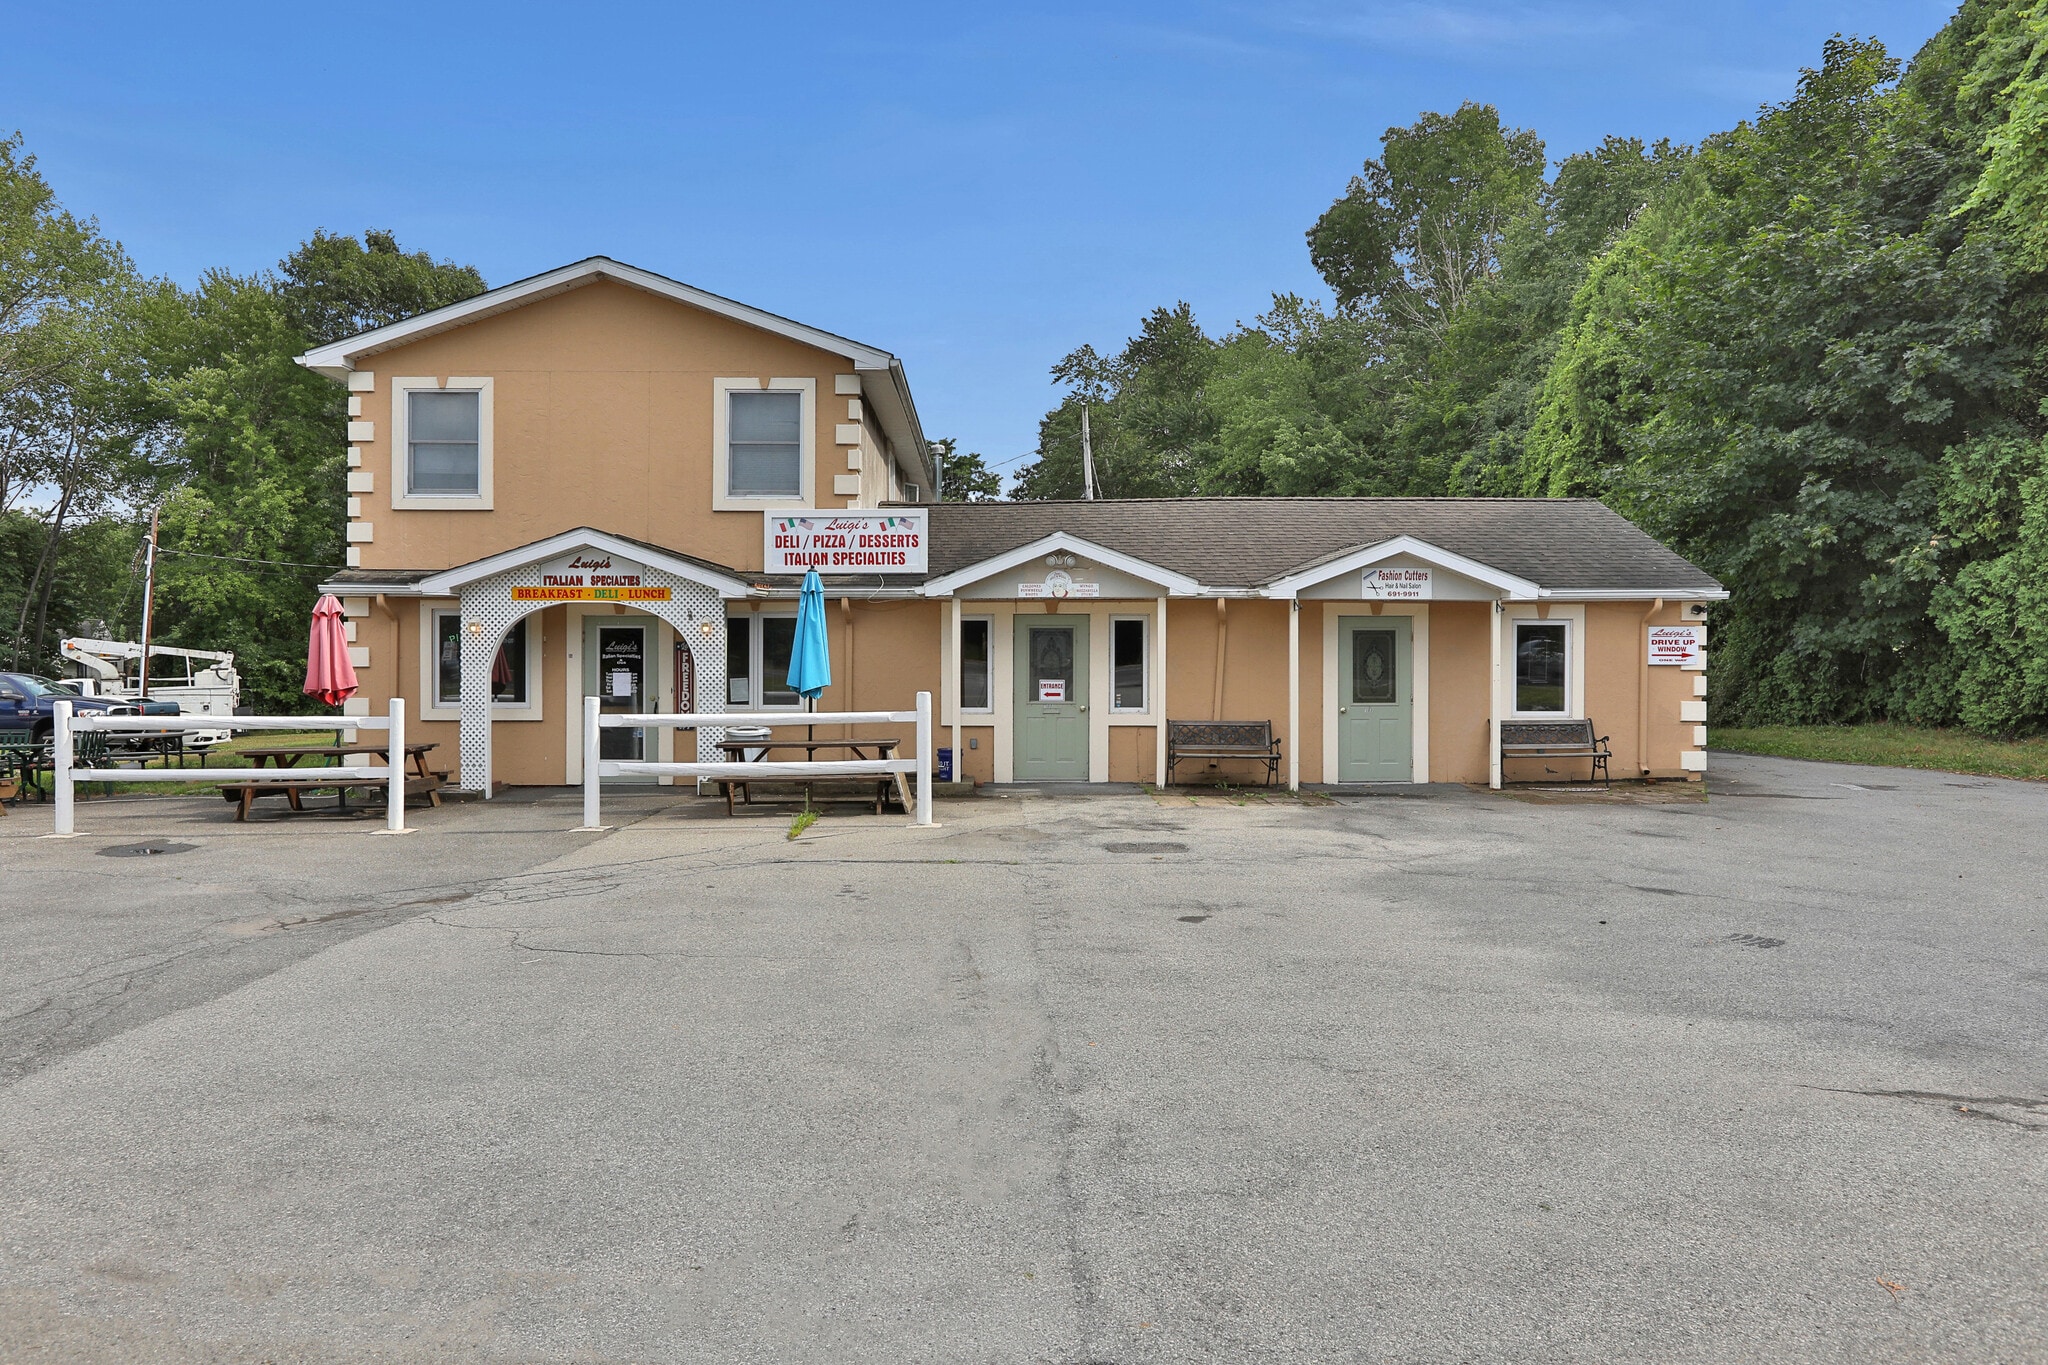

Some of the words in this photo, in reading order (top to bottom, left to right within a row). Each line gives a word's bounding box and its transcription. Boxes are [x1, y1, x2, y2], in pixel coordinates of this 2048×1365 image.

[825, 518, 869, 534] Luigi's
[775, 535, 800, 548] DELI
[813, 535, 846, 548] PIZZA
[859, 534, 919, 548] DESSERTS
[568, 556, 611, 572] Luigi's
[784, 552, 828, 566] ITALIAN
[833, 552, 906, 565] SPECIALTIES
[543, 575, 583, 586] ITALIAN
[590, 575, 640, 586] SPECIALTIES
[1378, 570, 1402, 581] Fashion
[1404, 570, 1428, 581] Cutters
[517, 589, 583, 599] BREAKFAST
[594, 589, 619, 598] DELI
[628, 589, 665, 598] LUNCH
[1651, 628, 1692, 638] Luigi's
[605, 641, 638, 653] Luigi's
